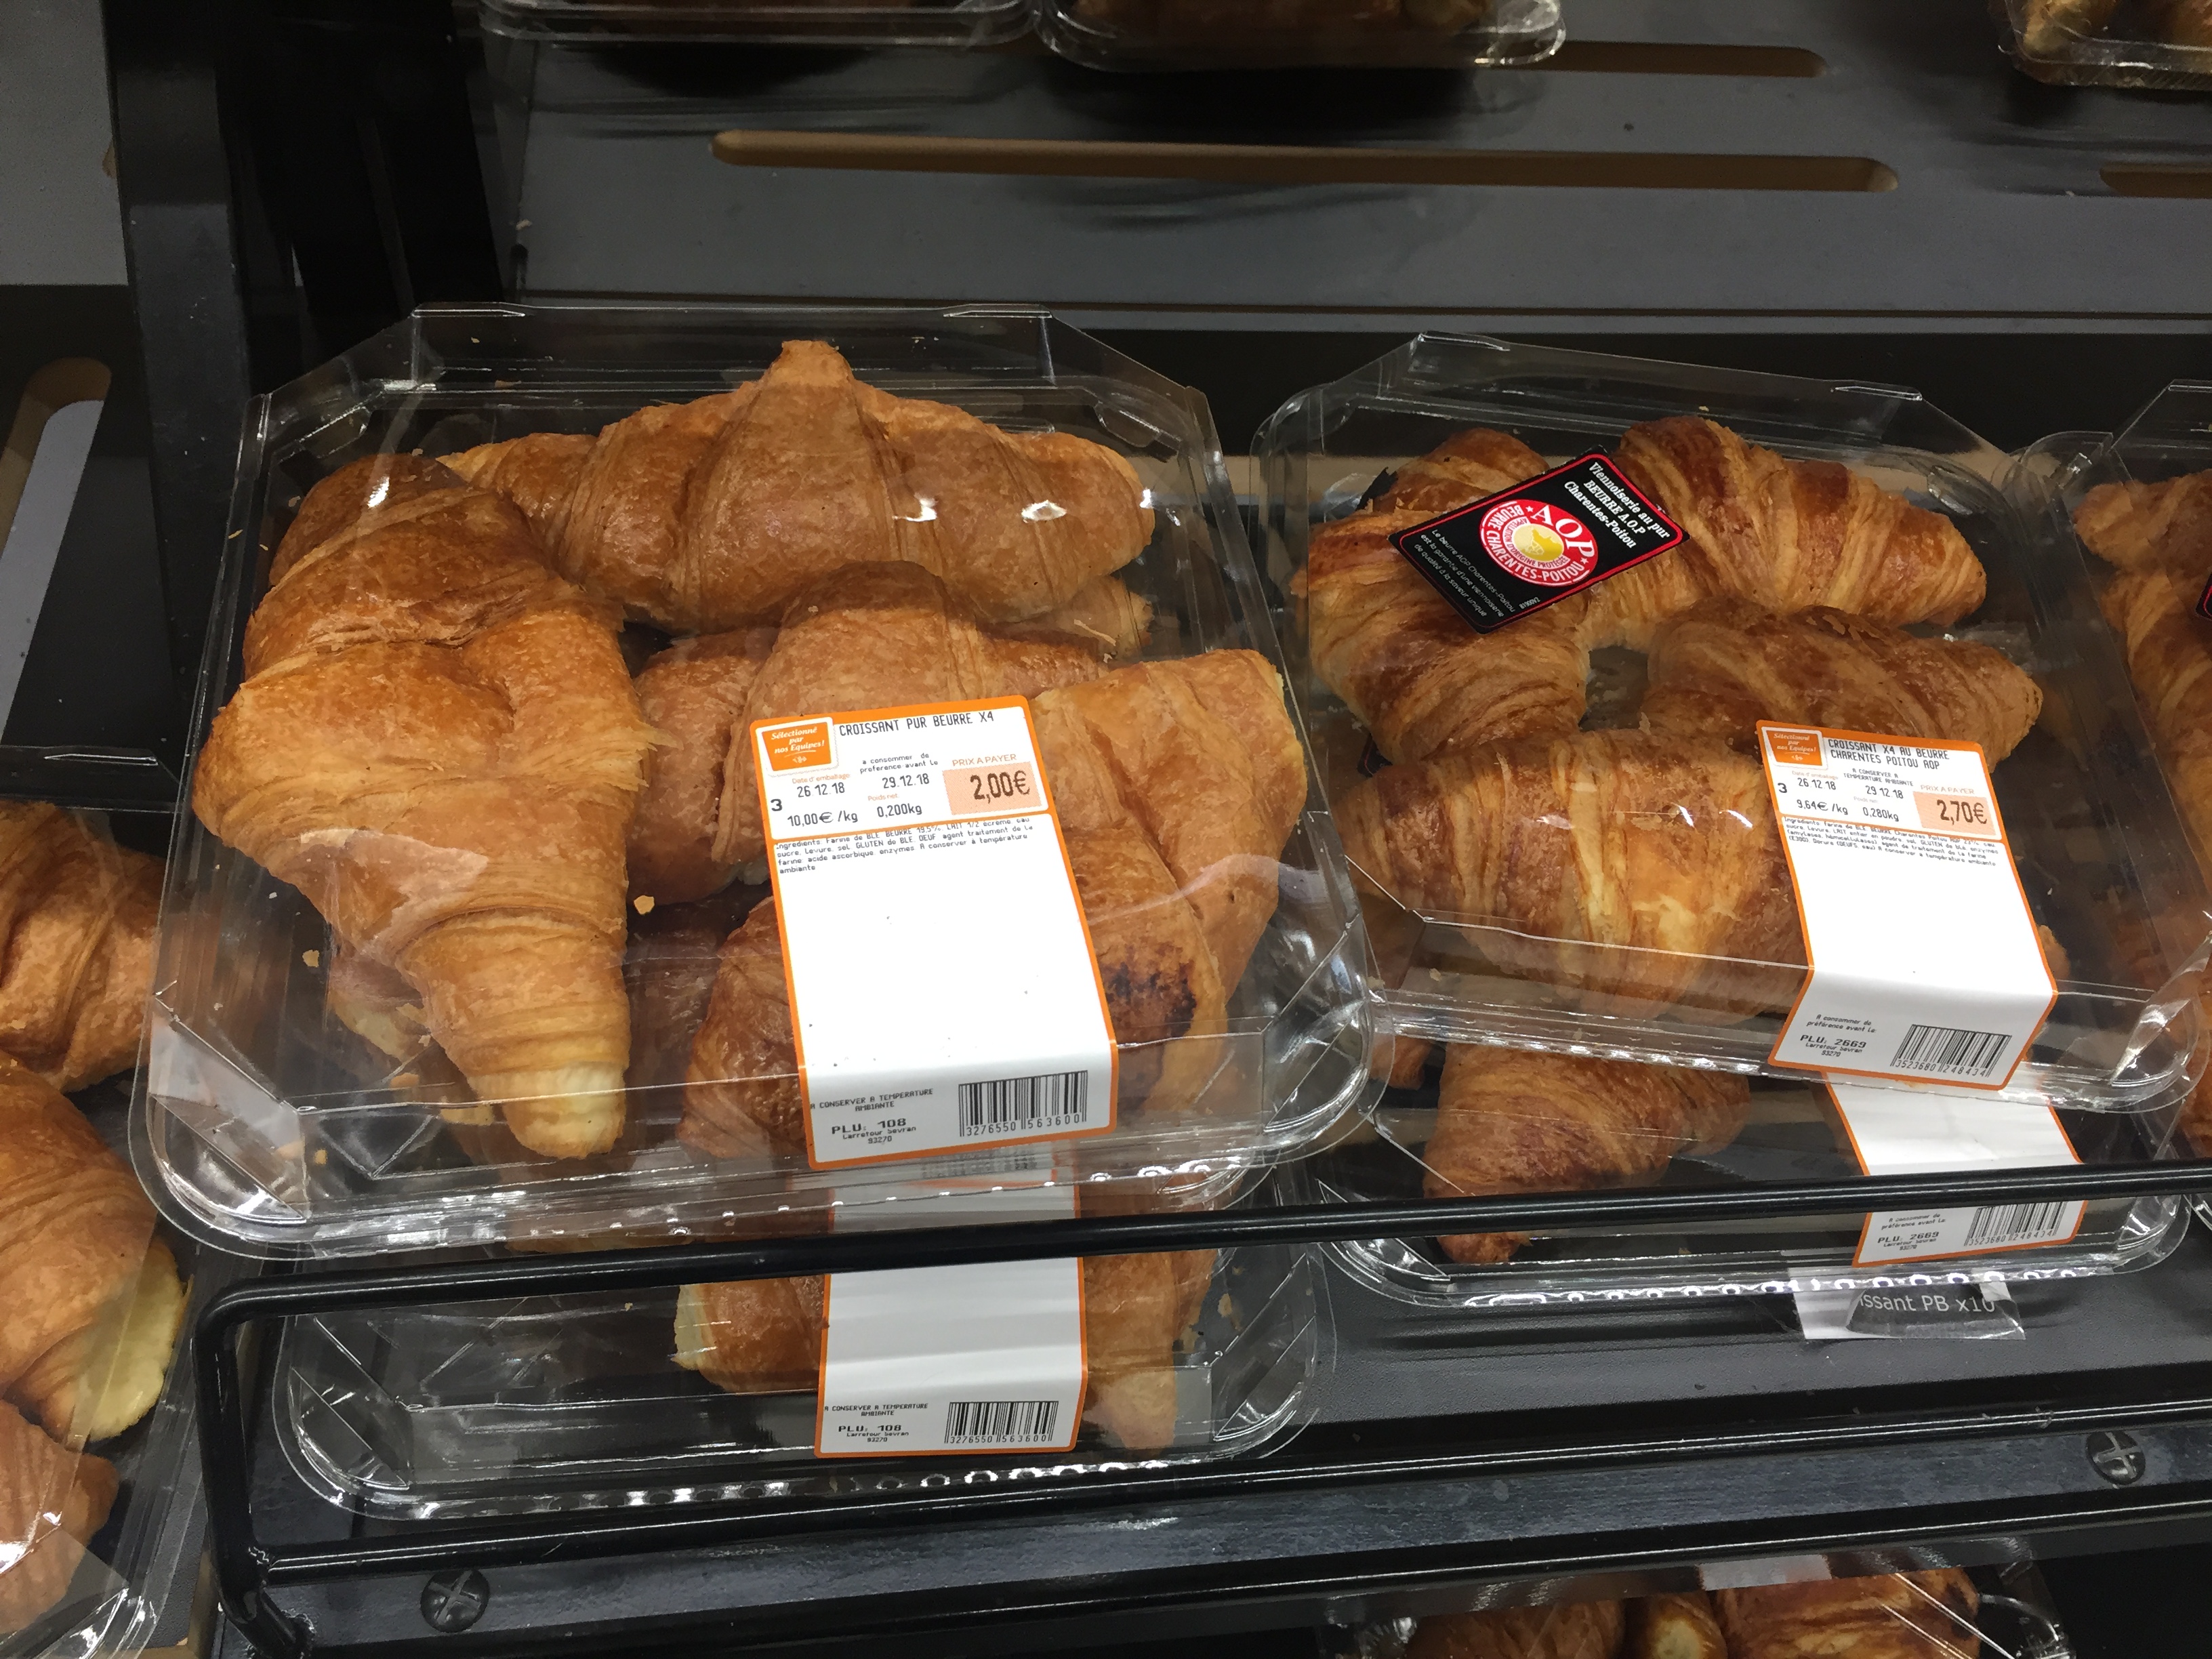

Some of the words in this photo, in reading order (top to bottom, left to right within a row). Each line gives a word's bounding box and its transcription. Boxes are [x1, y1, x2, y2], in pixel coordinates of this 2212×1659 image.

[1584, 480, 1623, 514] BEURRE
[1618, 514, 1645, 533] A.O.P
[1589, 462, 1640, 512] Viennoiserie
[1638, 513, 1653, 525] au
[1647, 523, 1670, 538] pur
[1488, 505, 1524, 531] BEURRE
[1565, 481, 1636, 548] Charentes-Poitou
[1530, 505, 1595, 557] AOP
[1439, 537, 1457, 554] beurre
[1456, 555, 1471, 565] AOP
[1486, 530, 1584, 581] CHARENTES-POITOU
[839, 720, 899, 736] CROISSANT
[906, 717, 927, 729] PUR
[933, 712, 972, 727] BEURRE
[978, 709, 994, 722] X4
[771, 727, 817, 740] Sélectionné
[788, 736, 804, 745] par
[773, 746, 788, 754] nos
[1827, 737, 1877, 752] CROISSANT
[1881, 743, 1895, 754] X4
[1898, 745, 1911, 756] AU
[1914, 746, 1949, 759] BEURRE
[870, 756, 912, 764] consommer
[951, 758, 974, 766] PRIX
[982, 754, 1017, 763] PAYER
[1830, 750, 1881, 763] CHARENTES
[1886, 756, 1918, 767] POITOU
[1923, 760, 1940, 769] AOP
[1859, 769, 1891, 777] CONSERVER
[882, 773, 929, 788] 29.12.18
[970, 770, 1030, 804] 2,00€
[1797, 778, 1836, 790] 26.12.18
[797, 782, 844, 798] 26.12.18
[1778, 783, 1787, 793] 3
[1865, 785, 1903, 799] 29.12.18
[1946, 785, 1974, 795] PAYER
[771, 799, 782, 811] 3
[877, 803, 922, 817] 0,200kg
[1832, 804, 1848, 815] /kg
[787, 812, 833, 827] 10,00€
[838, 811, 858, 823] /kg
[1863, 807, 1899, 821] 0,280kg
[1937, 800, 1987, 825] 2,70€
[856, 840, 884, 848] GLUTEN
[943, 831, 963, 840] agent
[968, 827, 1008, 836] traitement
[780, 865, 815, 874] ambiante
[1823, 1016, 1861, 1025] consommer
[1835, 1039, 1866, 1048] 2669
[1894, 1059, 1938, 1072] 3523680
[1942, 1065, 1986, 1077] 248434
[819, 1097, 868, 1109] CONSERVER
[880, 1088, 933, 1102] TEMPERATURE
[855, 1101, 894, 1111] AMBIANTE
[878, 1118, 906, 1128] 108
[966, 1122, 1017, 1136] 3276550
[1027, 1113, 1080, 1129] 563600
[1921, 1295, 1949, 1311] PB
[950, 1435, 993, 1443] 3276550
[1002, 1434, 1046, 1443] 563600
